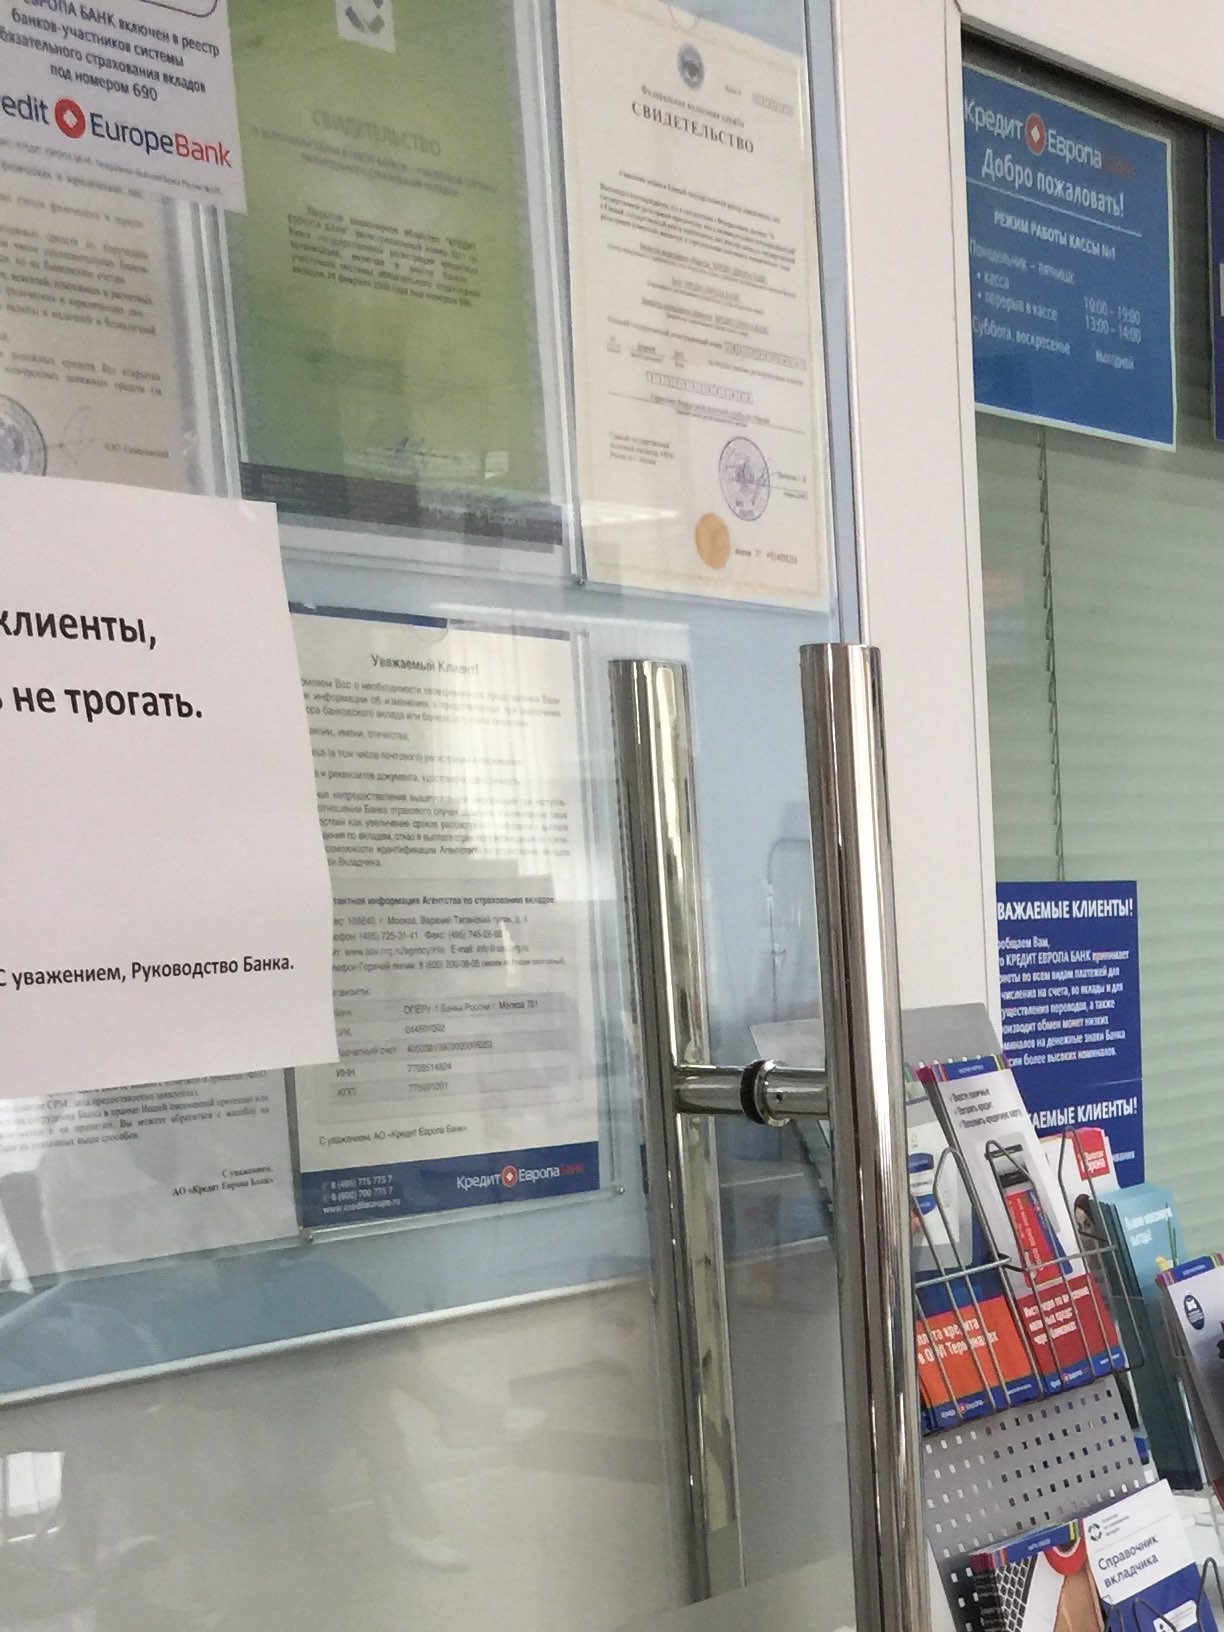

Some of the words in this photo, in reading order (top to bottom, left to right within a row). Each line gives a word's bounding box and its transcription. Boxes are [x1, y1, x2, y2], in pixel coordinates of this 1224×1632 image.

[11, 8, 131, 52] банков-участников
[134, 44, 184, 67] системы
[24, 0, 77, 17] ВРОПА
[80, 4, 117, 28] БАНК
[118, 17, 170, 42] включен
[172, 35, 179, 45] в
[181, 36, 220, 57] реестр
[0, 25, 83, 61] бязательного
[86, 52, 160, 81] страхования
[163, 72, 206, 94] вкладов
[50, 63, 72, 81] под
[75, 72, 130, 94] номером
[133, 83, 158, 101] 690
[0, 94, 49, 125] edit
[90, 112, 232, 168] EuropeBank
[631, 101, 754, 153] СВИДЕТЕЛЬСТВО
[964, 97, 1024, 140] Кредит
[981, 148, 1034, 190] Добро
[1037, 172, 1124, 218] пожаловать!
[994, 211, 1030, 236] РЕЖИМ
[1031, 222, 1068, 247] РАБОТЫ
[1069, 234, 1100, 257] КАССЫ
[983, 270, 1010, 290] касса
[0, 609, 157, 650] клиенты,
[371, 654, 435, 673] Уважаемый
[13, 686, 56, 713] не
[63, 688, 203, 722] трогать.
[997, 899, 1070, 921] ВАЖАЕМЫЕ
[1072, 898, 1134, 918] КЛИЕНТЫ!
[997, 936, 1032, 951] ообщаем
[1033, 936, 1050, 949] Вам,
[1006, 952, 1037, 968] КРЕДИТ
[1038, 950, 1070, 965] ЕВРОПА
[1070, 949, 1092, 962] БАНК
[11, 965, 127, 990] уважением,
[131, 957, 239, 982] Руководство
[243, 954, 294, 975] Банка.
[1001, 988, 1036, 1000] числения
[1001, 1003, 1049, 1021] уществления
[1002, 1021, 1037, 1035] оизводит
[1105, 1028, 1126, 1040] Банка
[1023, 1051, 1046, 1066] более
[1077, 1097, 1137, 1123] КЛИЕНТЫ!
[319, 1136, 326, 1146] С
[373, 1130, 386, 1141] АО
[418, 1125, 445, 1138] Европа
[172, 1185, 187, 1197] АО
[456, 1173, 501, 1191] Кредит
[944, 1317, 980, 1340] креита
[1098, 1535, 1159, 1571] Справочник
[1104, 1554, 1159, 1588] вкладчика
